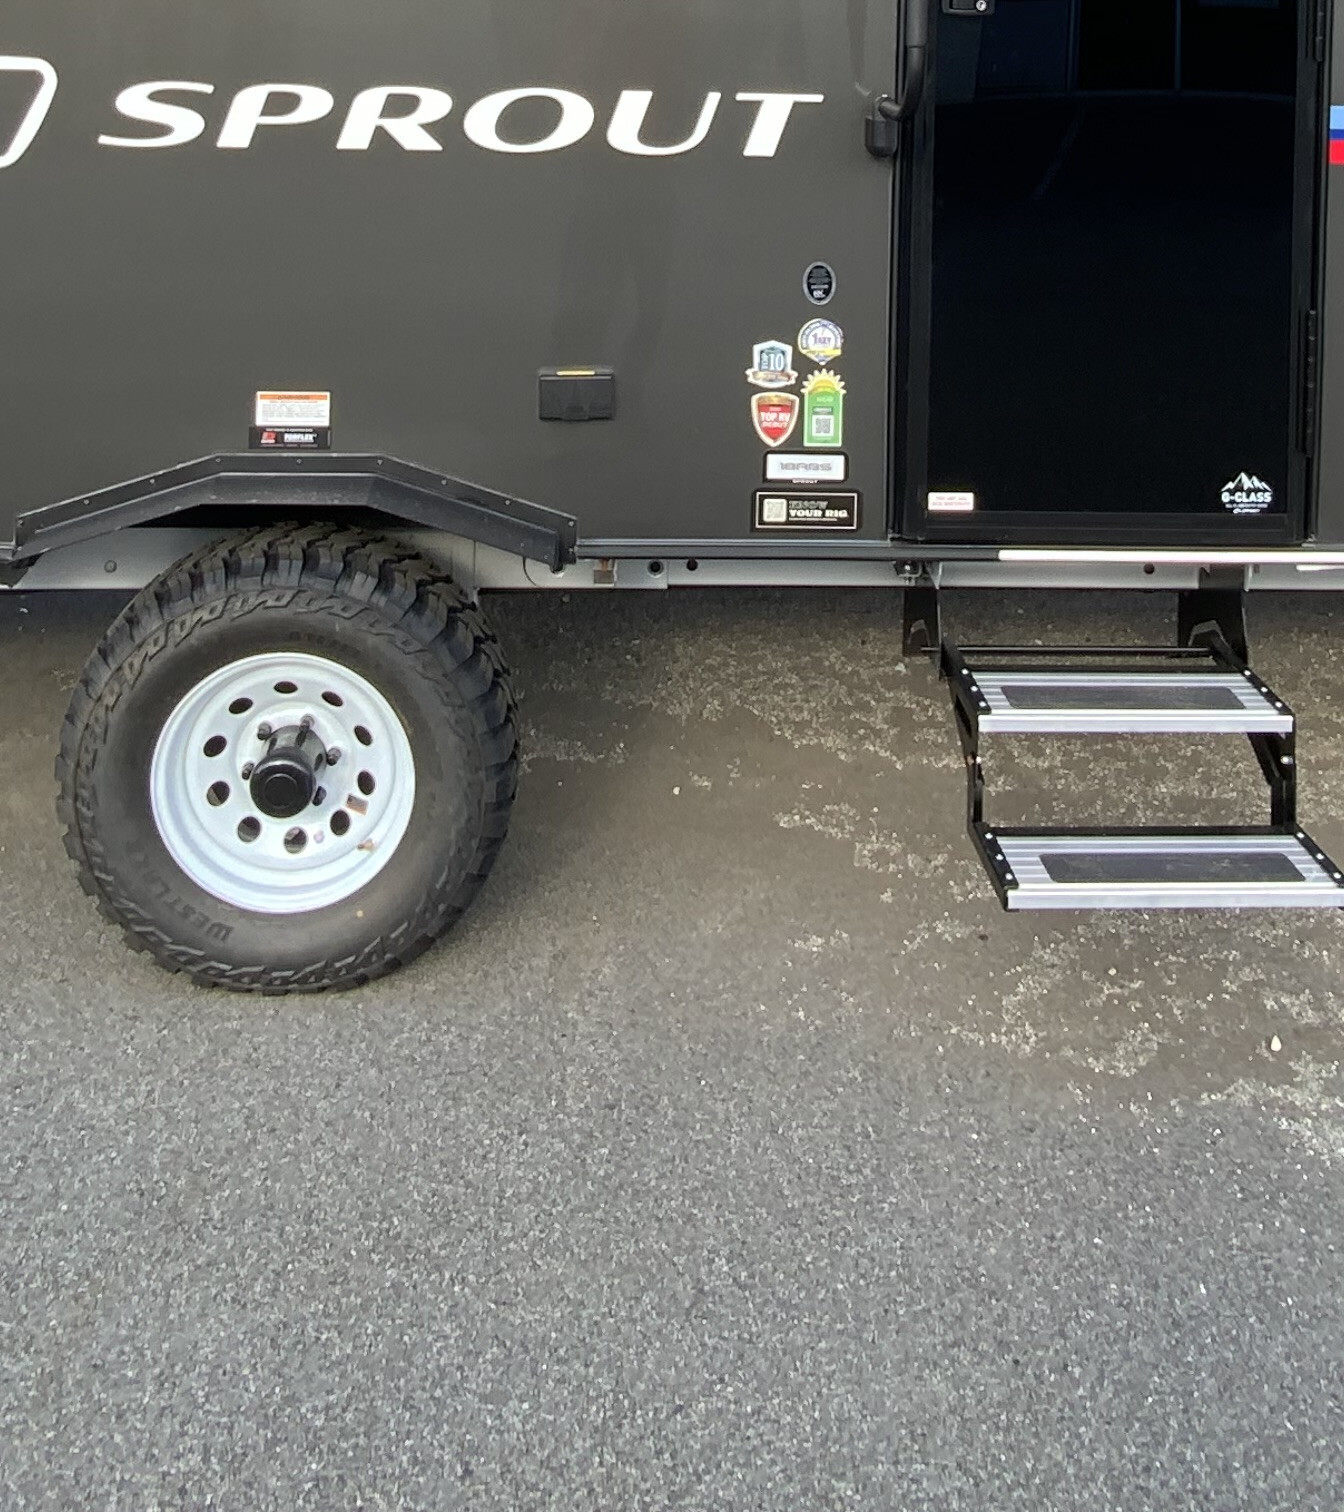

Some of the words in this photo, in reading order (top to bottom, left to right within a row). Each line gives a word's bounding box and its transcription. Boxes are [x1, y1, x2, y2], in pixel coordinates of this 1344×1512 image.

[98, 80, 825, 157] SPROUT
[769, 352, 785, 371] 10
[760, 411, 777, 422] TOP
